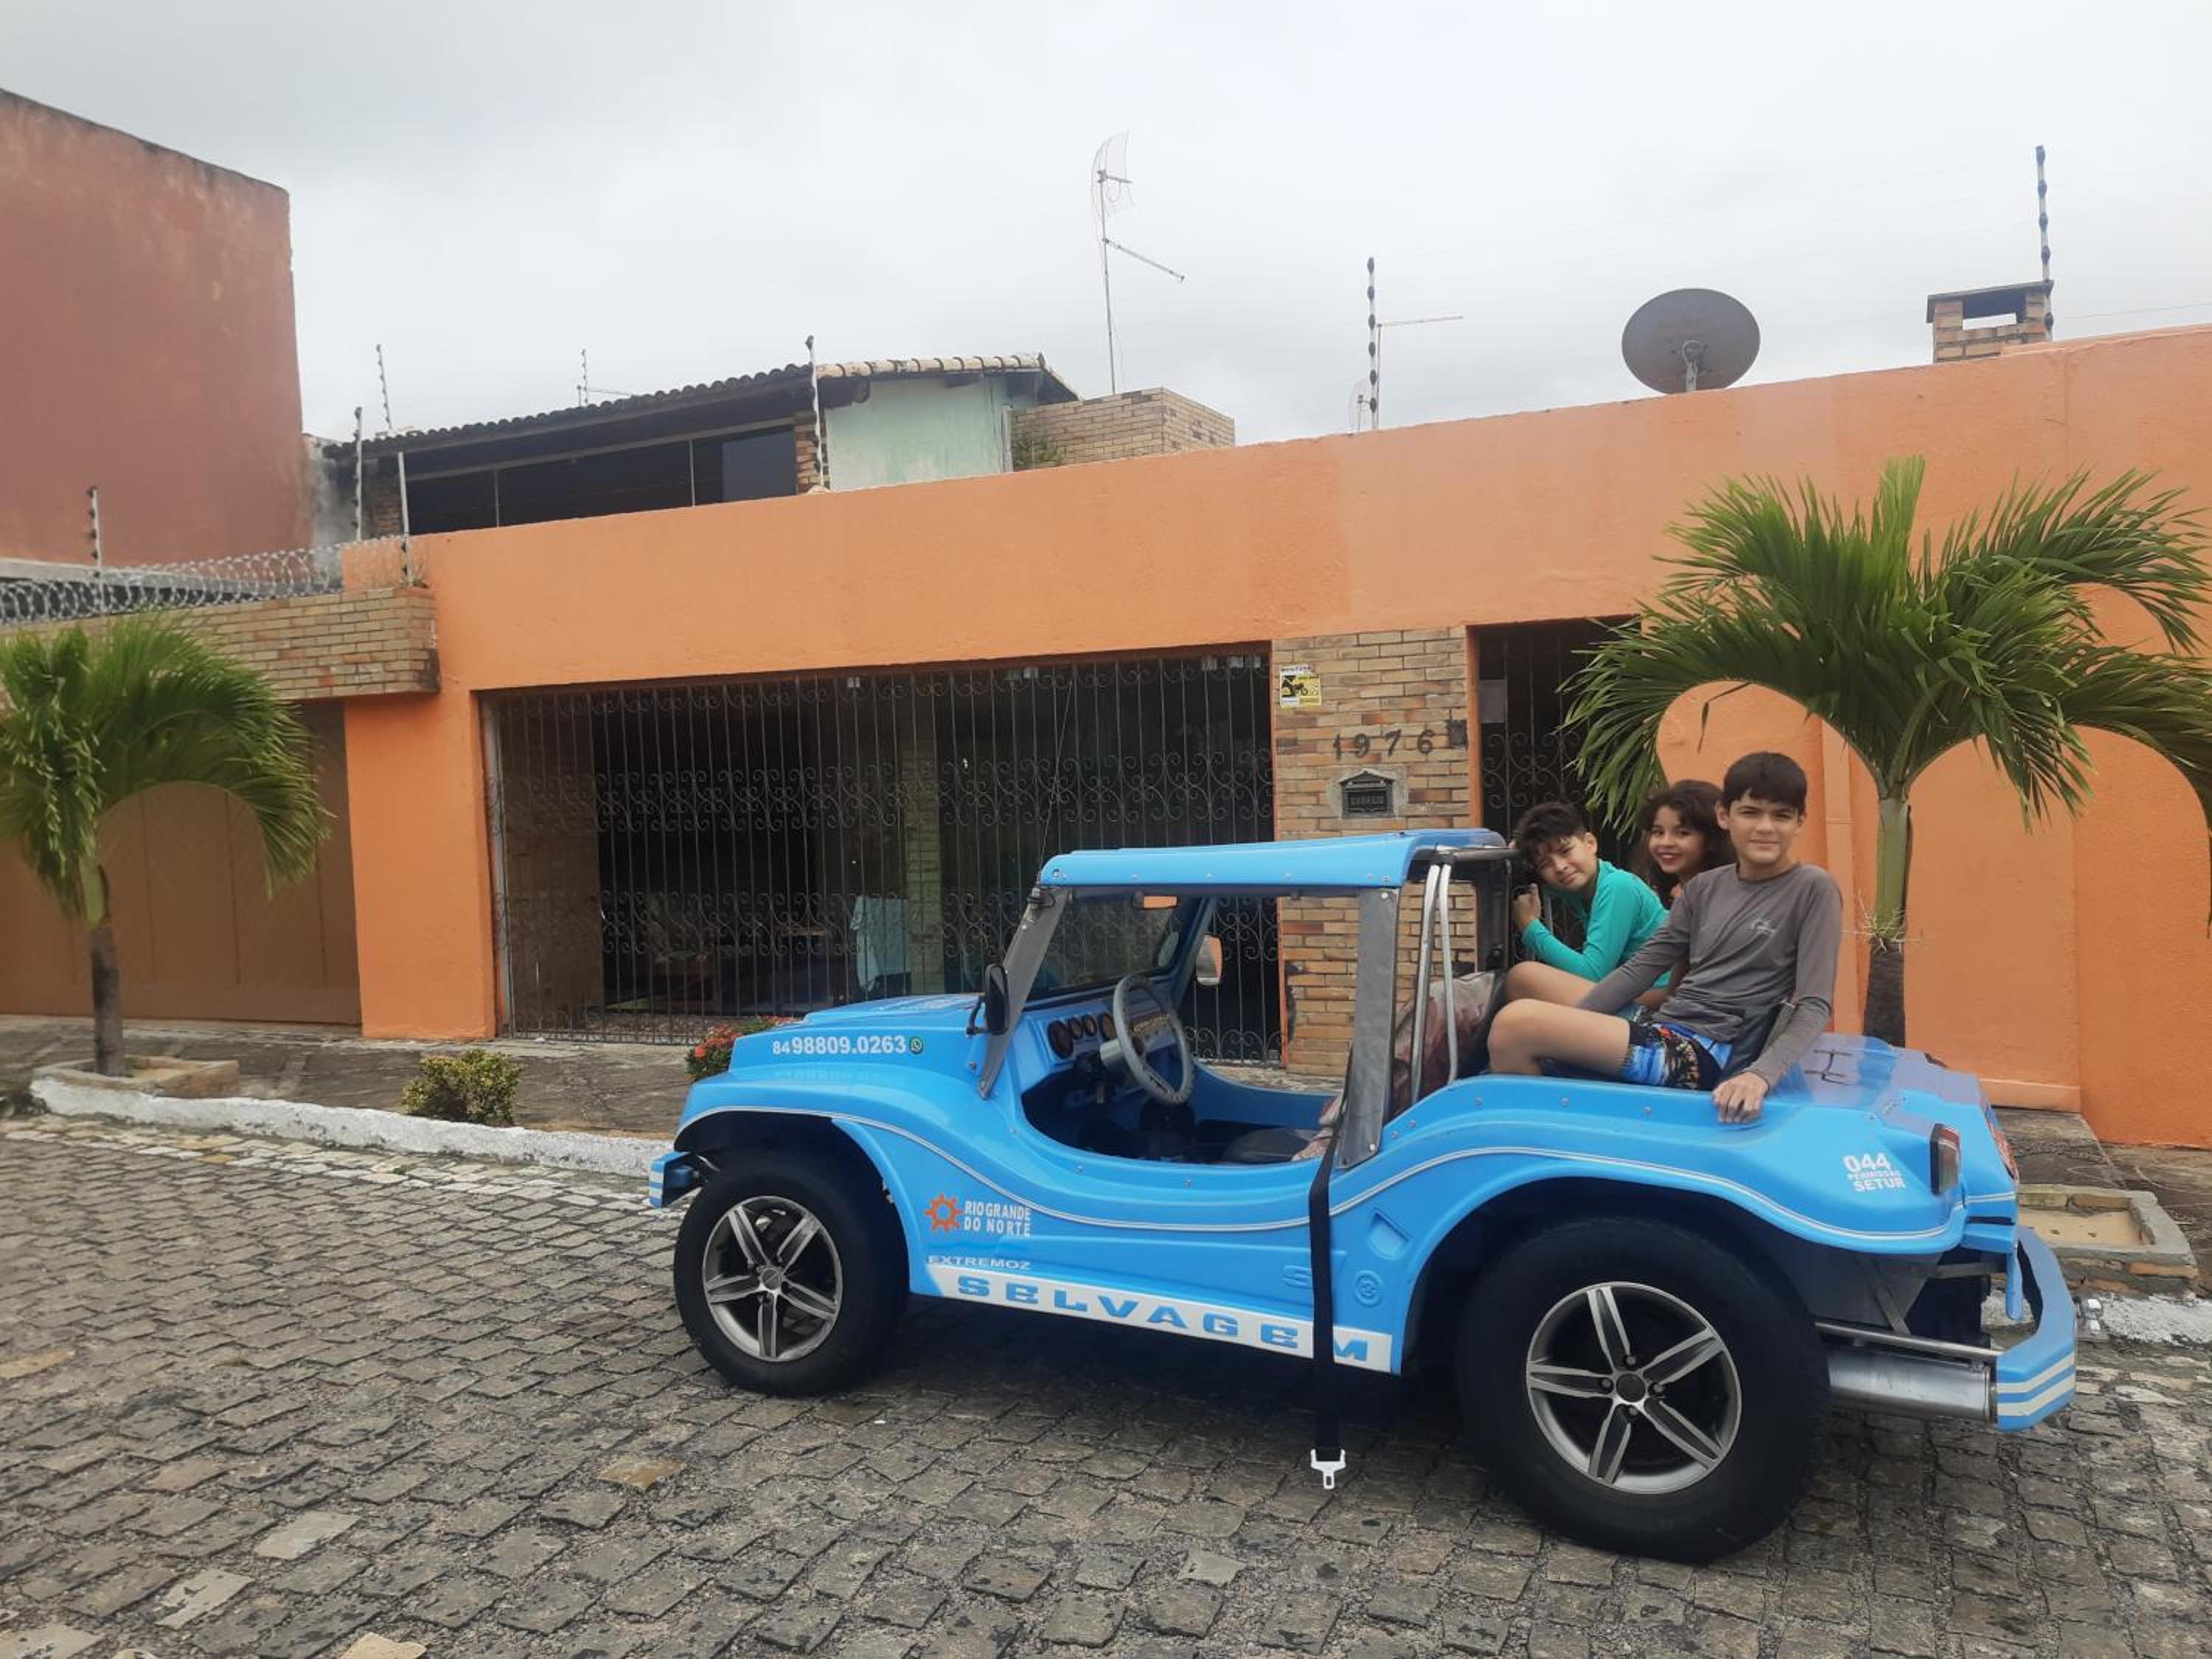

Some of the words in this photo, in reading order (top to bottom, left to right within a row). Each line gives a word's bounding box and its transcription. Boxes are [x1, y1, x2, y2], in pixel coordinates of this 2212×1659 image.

[1332, 729, 1436, 760] 1976
[1843, 1152, 1891, 1172] 044
[1853, 1178, 1906, 1192] SETUR
[964, 1200, 984, 1216] RIO
[986, 1203, 1031, 1222] GRANDE
[964, 1217, 981, 1232] DO
[987, 1218, 1031, 1238] NORTE
[928, 1255, 1031, 1270] EXTREMOZ
[958, 1275, 1368, 1362] SELVAGEM
